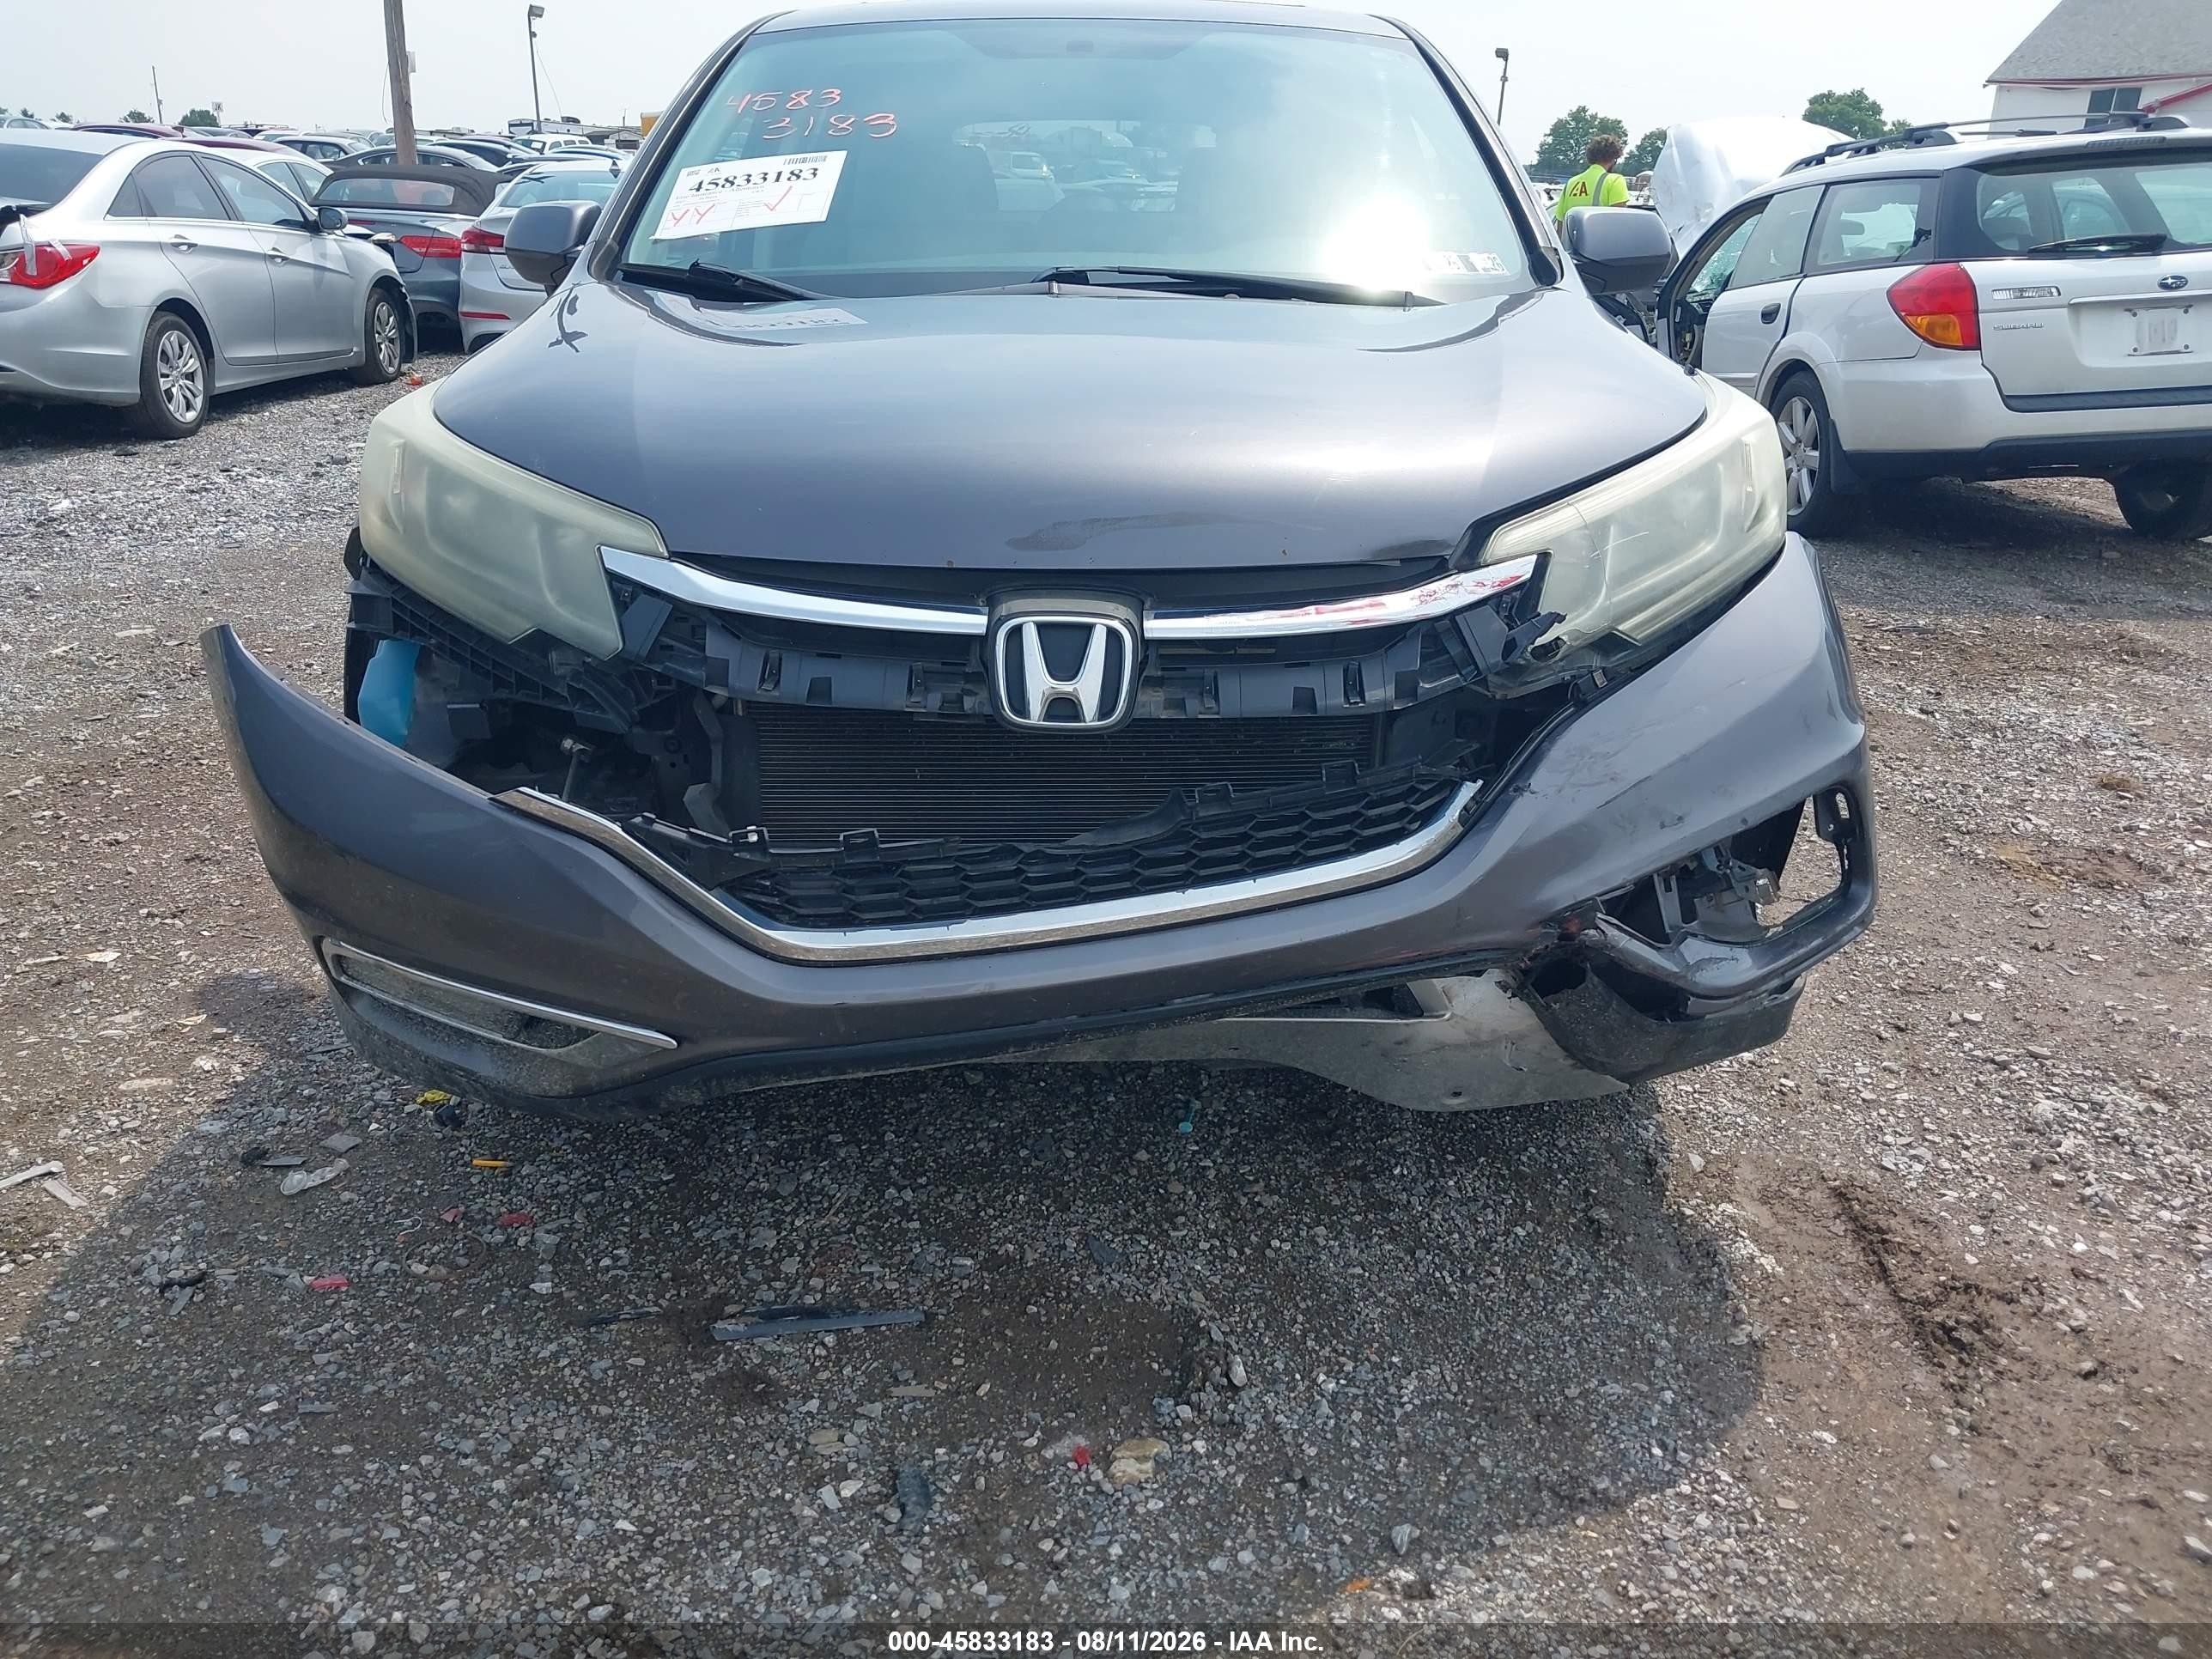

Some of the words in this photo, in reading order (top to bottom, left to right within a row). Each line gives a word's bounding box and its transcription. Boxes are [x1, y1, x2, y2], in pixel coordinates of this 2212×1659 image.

[726, 88, 842, 113] 4583
[762, 112, 898, 140] 3183
[689, 167, 819, 193] 45833183
[1992, 322, 2044, 331] SUBARU
